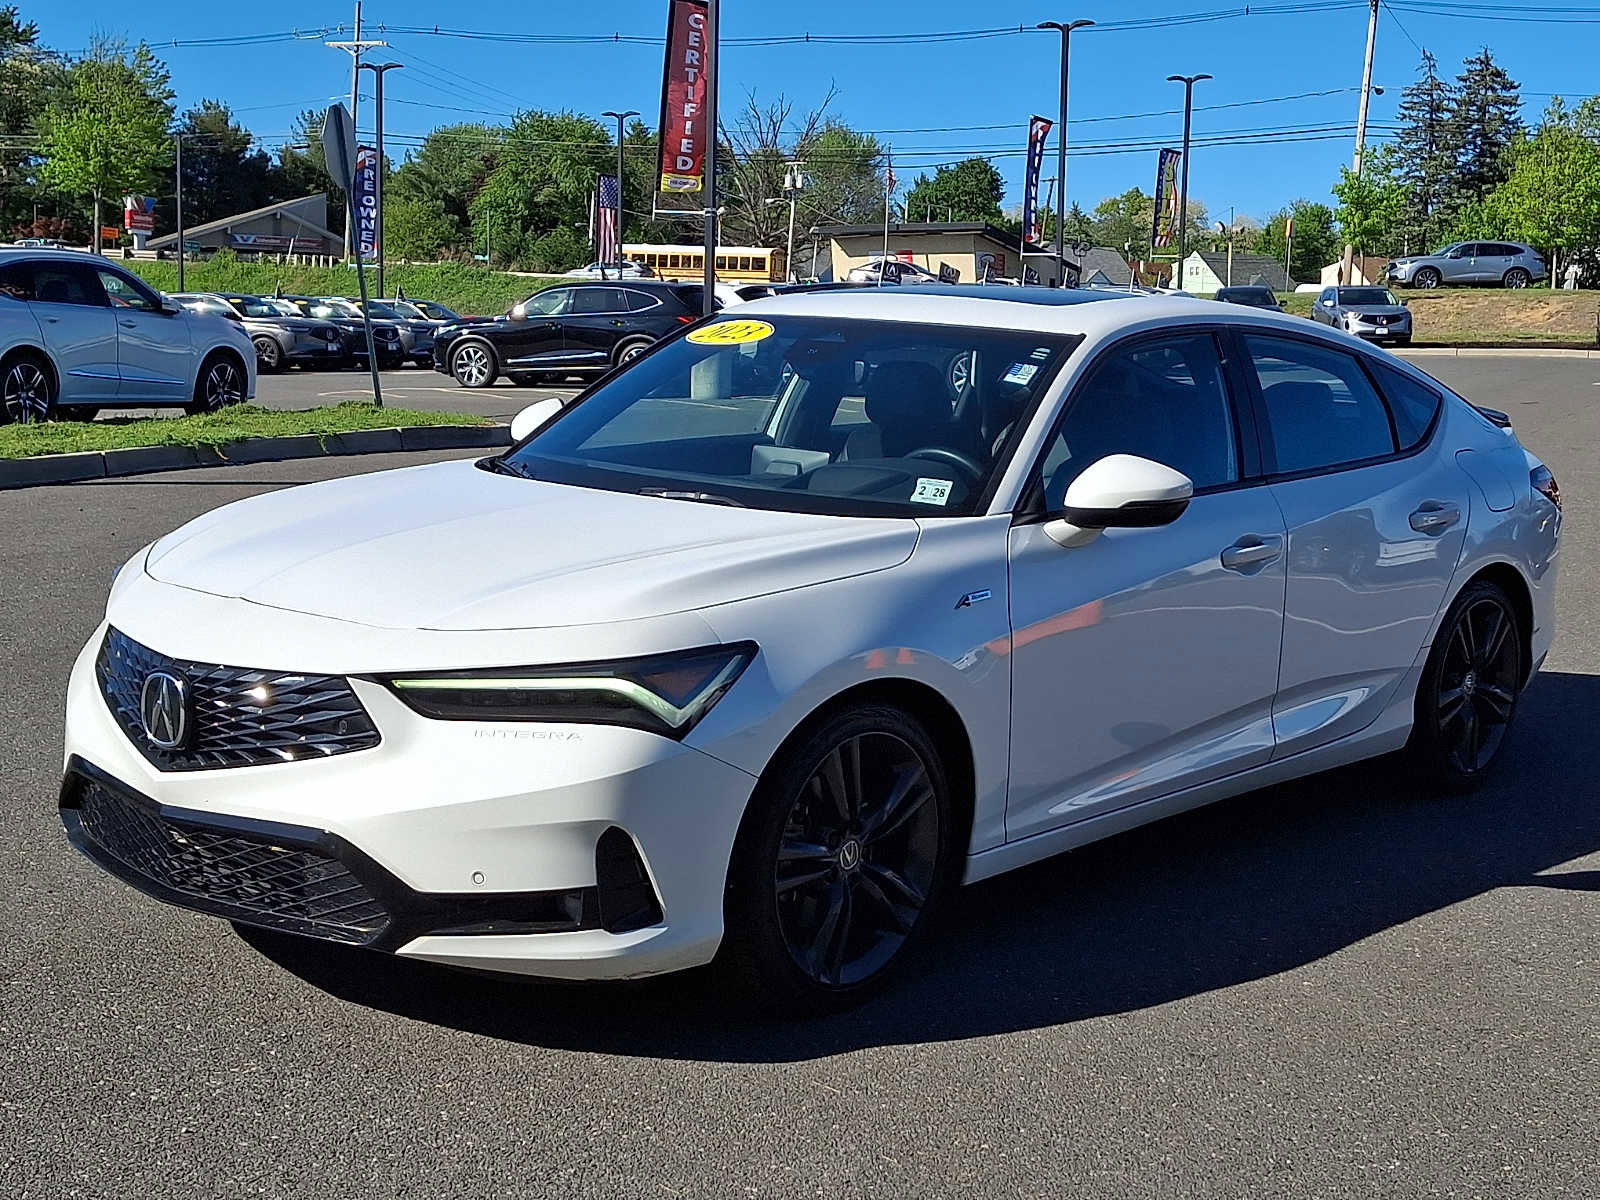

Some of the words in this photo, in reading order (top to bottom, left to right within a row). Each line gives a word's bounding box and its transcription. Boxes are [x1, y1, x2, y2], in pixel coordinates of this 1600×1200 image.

[676, 13, 704, 171] CERTIFIED
[360, 195, 377, 253] OWNED
[918, 486, 927, 496] 2
[932, 487, 946, 498] 28
[474, 729, 583, 741] INTEGRA
